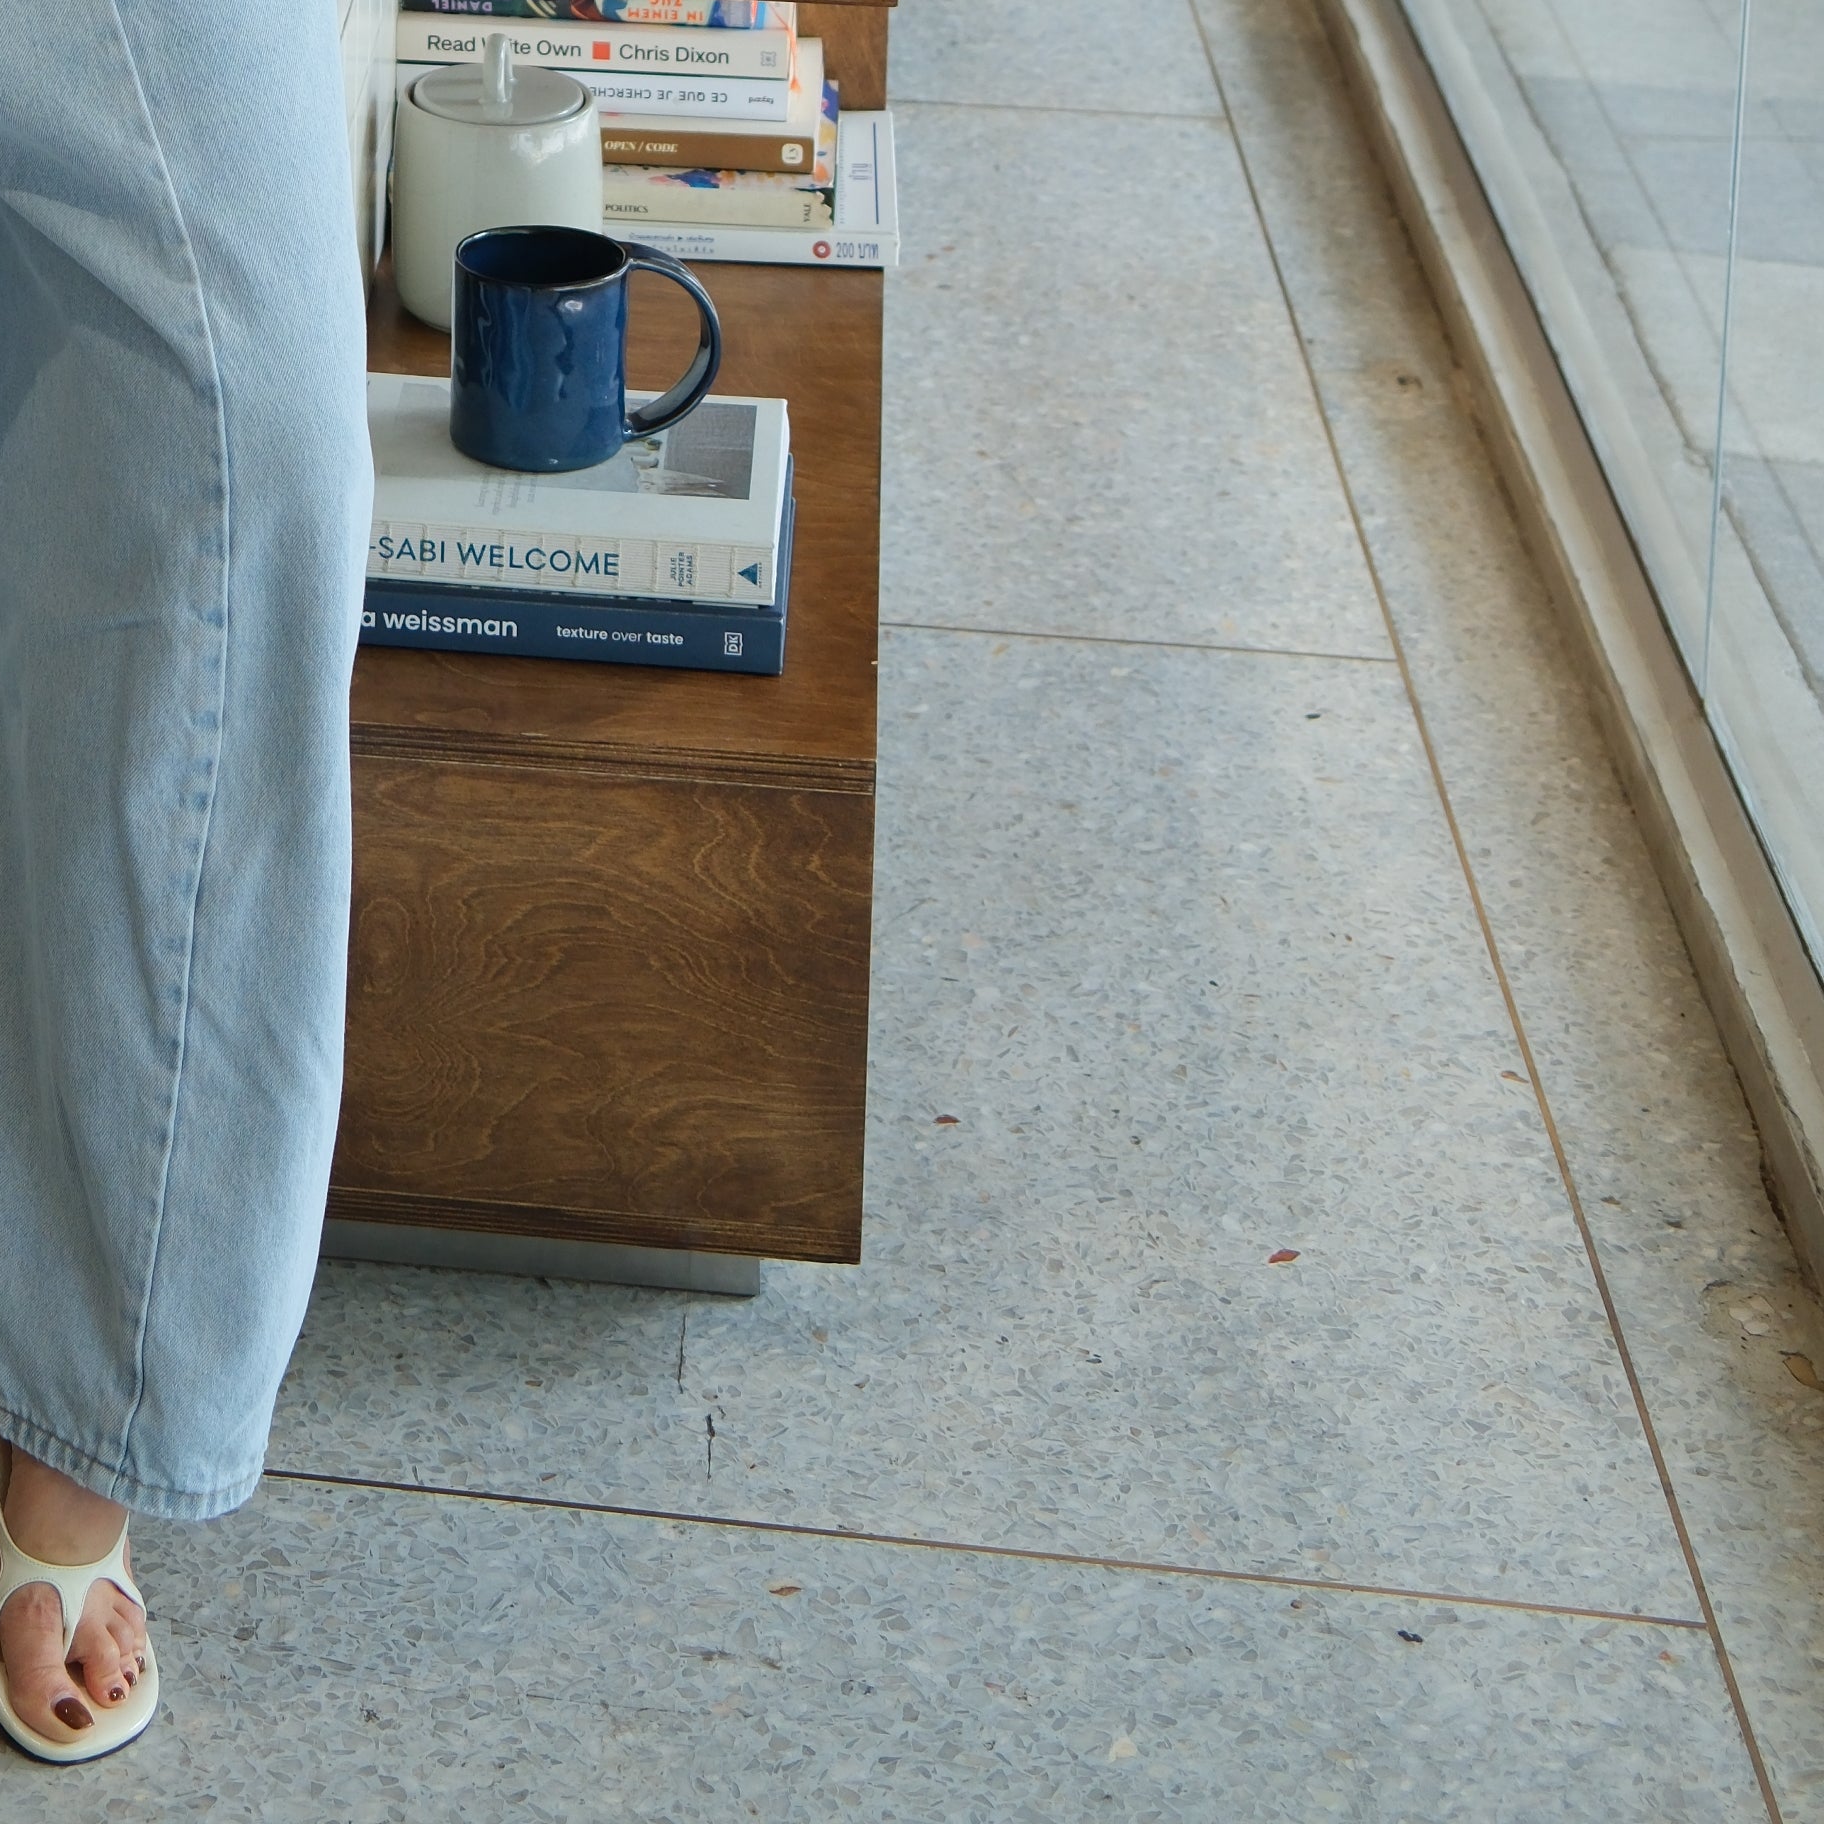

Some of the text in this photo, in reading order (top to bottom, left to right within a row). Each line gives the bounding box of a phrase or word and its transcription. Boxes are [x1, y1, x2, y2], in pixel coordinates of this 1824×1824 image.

[627, 7, 704, 22] IN EINEM
[427, 34, 729, 64] Read ite Own Chris Dixon
[589, 87, 728, 103] CE QUE JE CHERCHE
[605, 141, 636, 151] OPEN
[646, 142, 678, 153] CODE
[605, 204, 648, 214] POLITICS
[803, 204, 812, 223] YALE
[836, 242, 855, 258] 200
[858, 242, 879, 259] บาท
[456, 541, 621, 577] WELCOME
[383, 609, 518, 638] weissman
[556, 626, 684, 645] texture over taste
